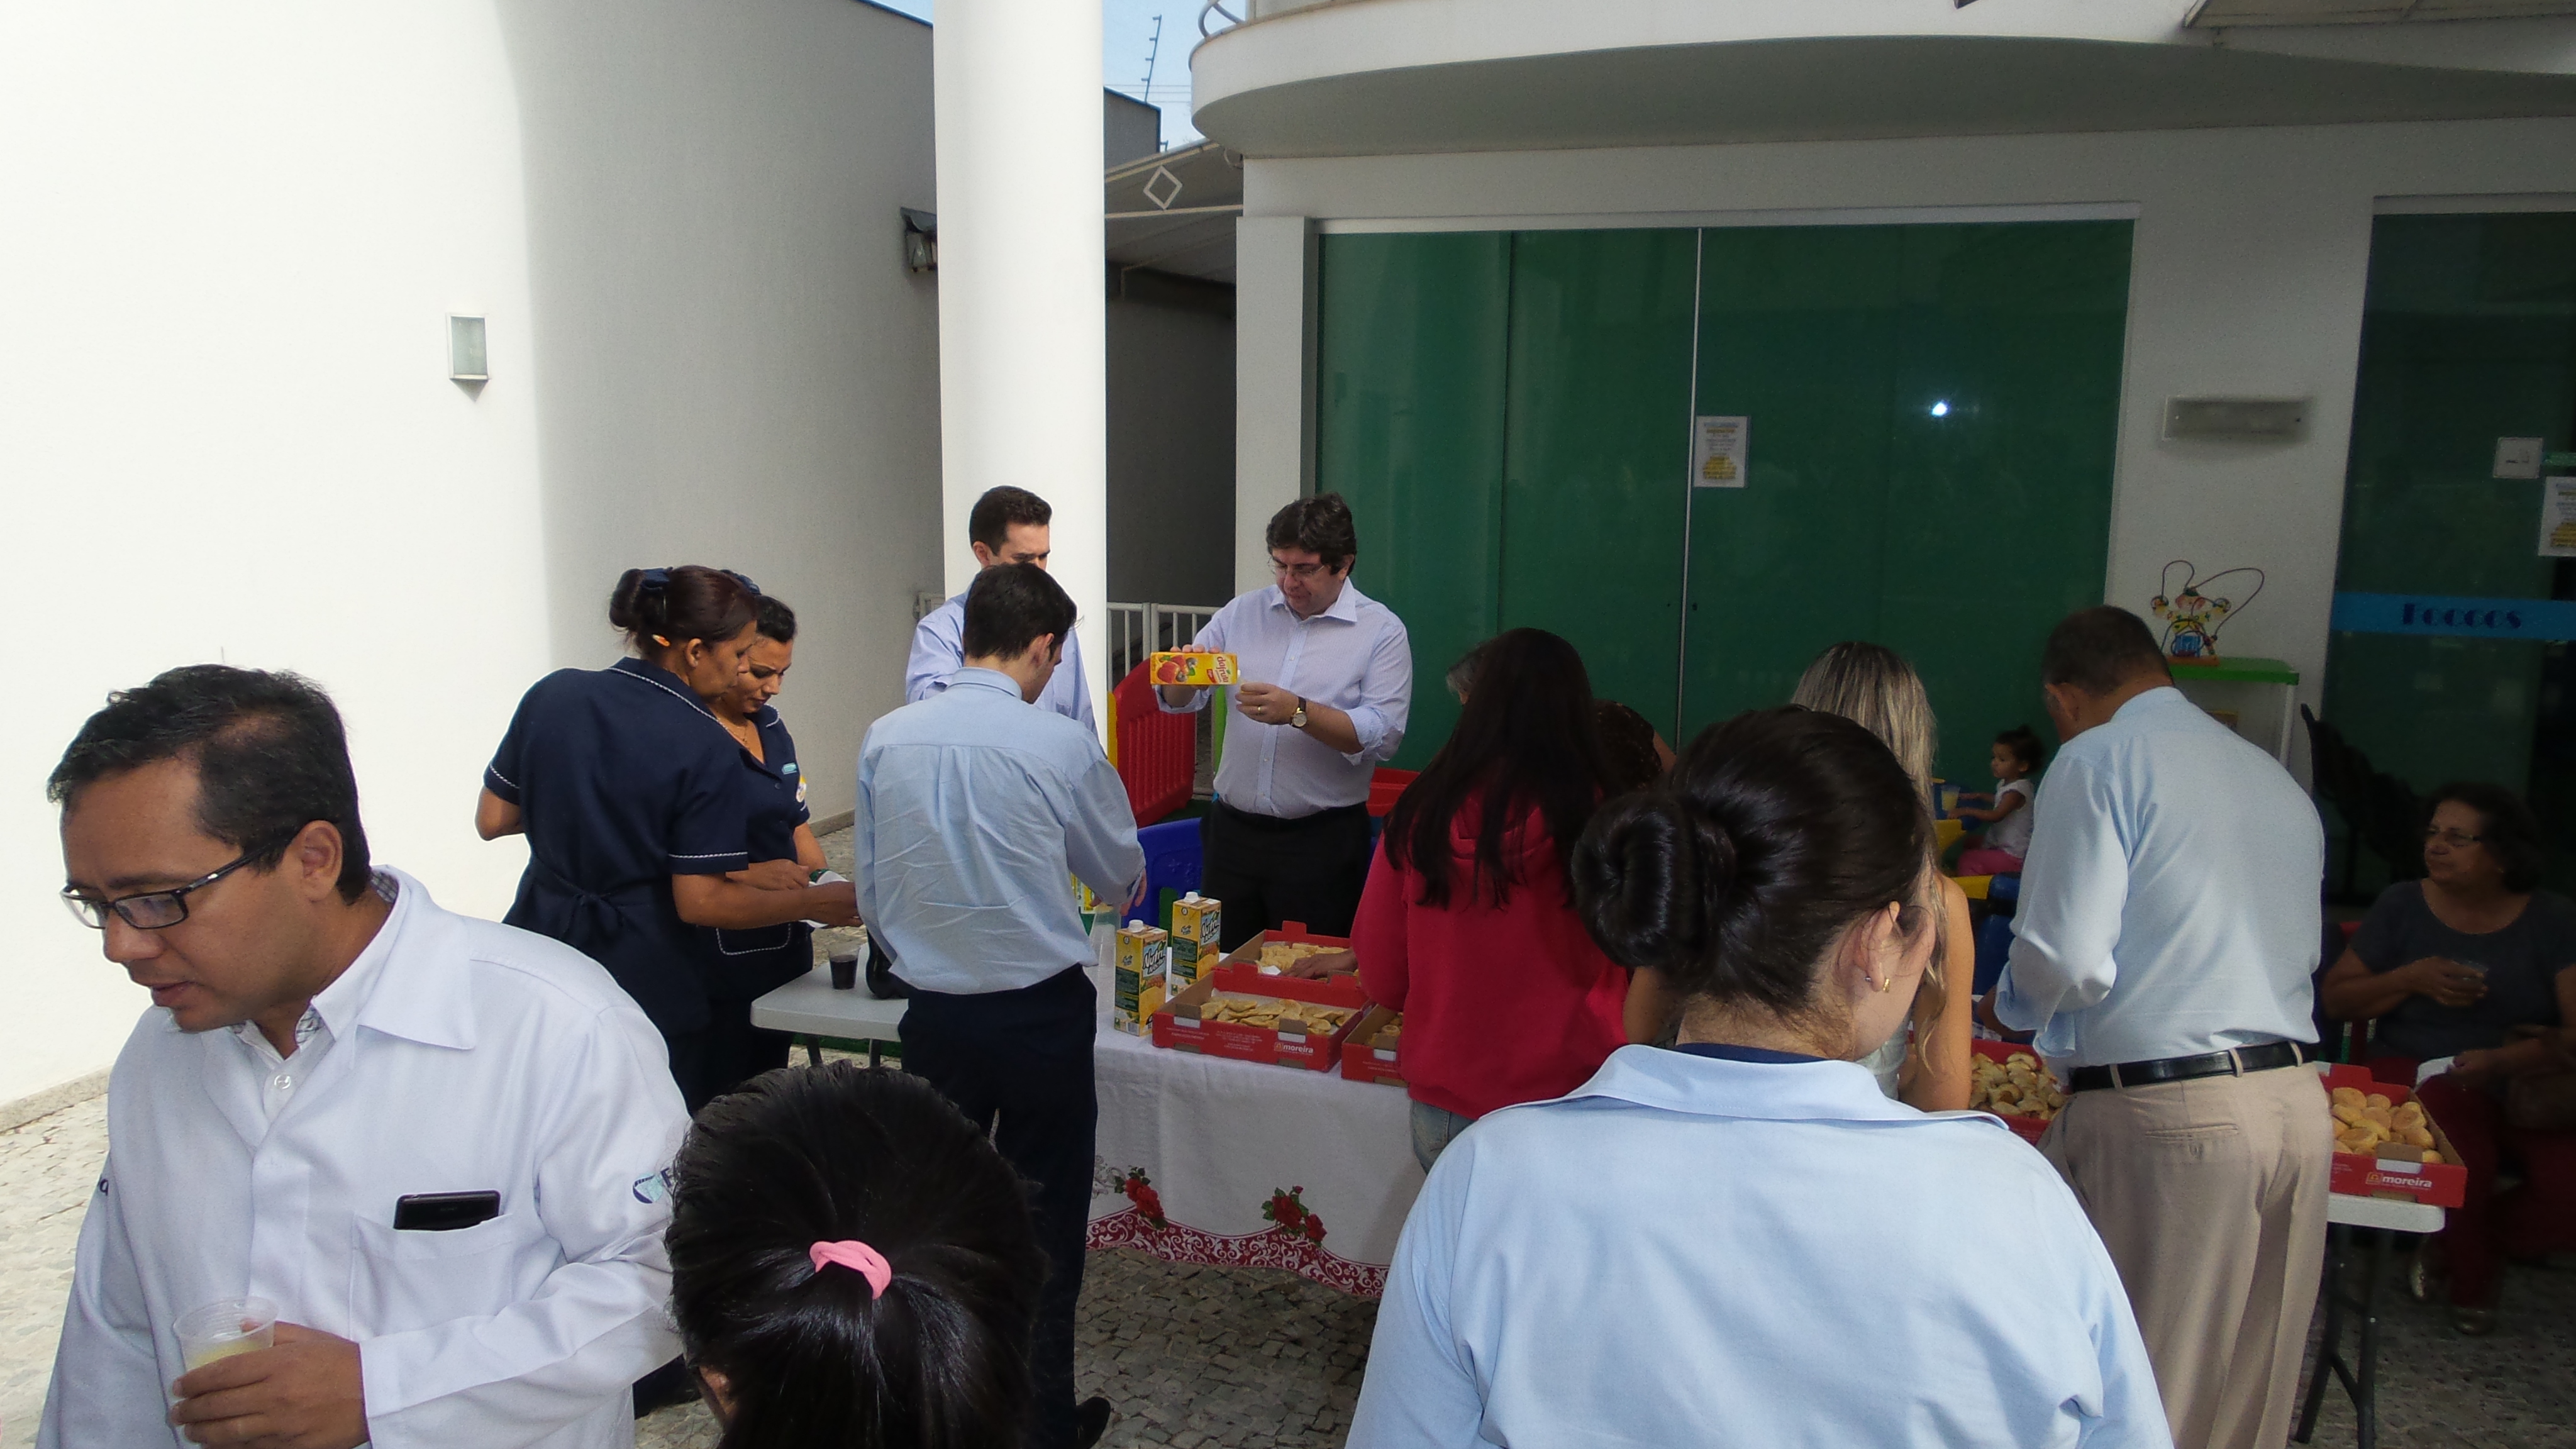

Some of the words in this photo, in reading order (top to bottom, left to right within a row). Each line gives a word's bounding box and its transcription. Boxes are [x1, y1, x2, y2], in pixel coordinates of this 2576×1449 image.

[1142, 946, 1166, 970] Nutri
[1283, 1045, 1314, 1054] moreira
[2382, 1175, 2432, 1188] moreira
